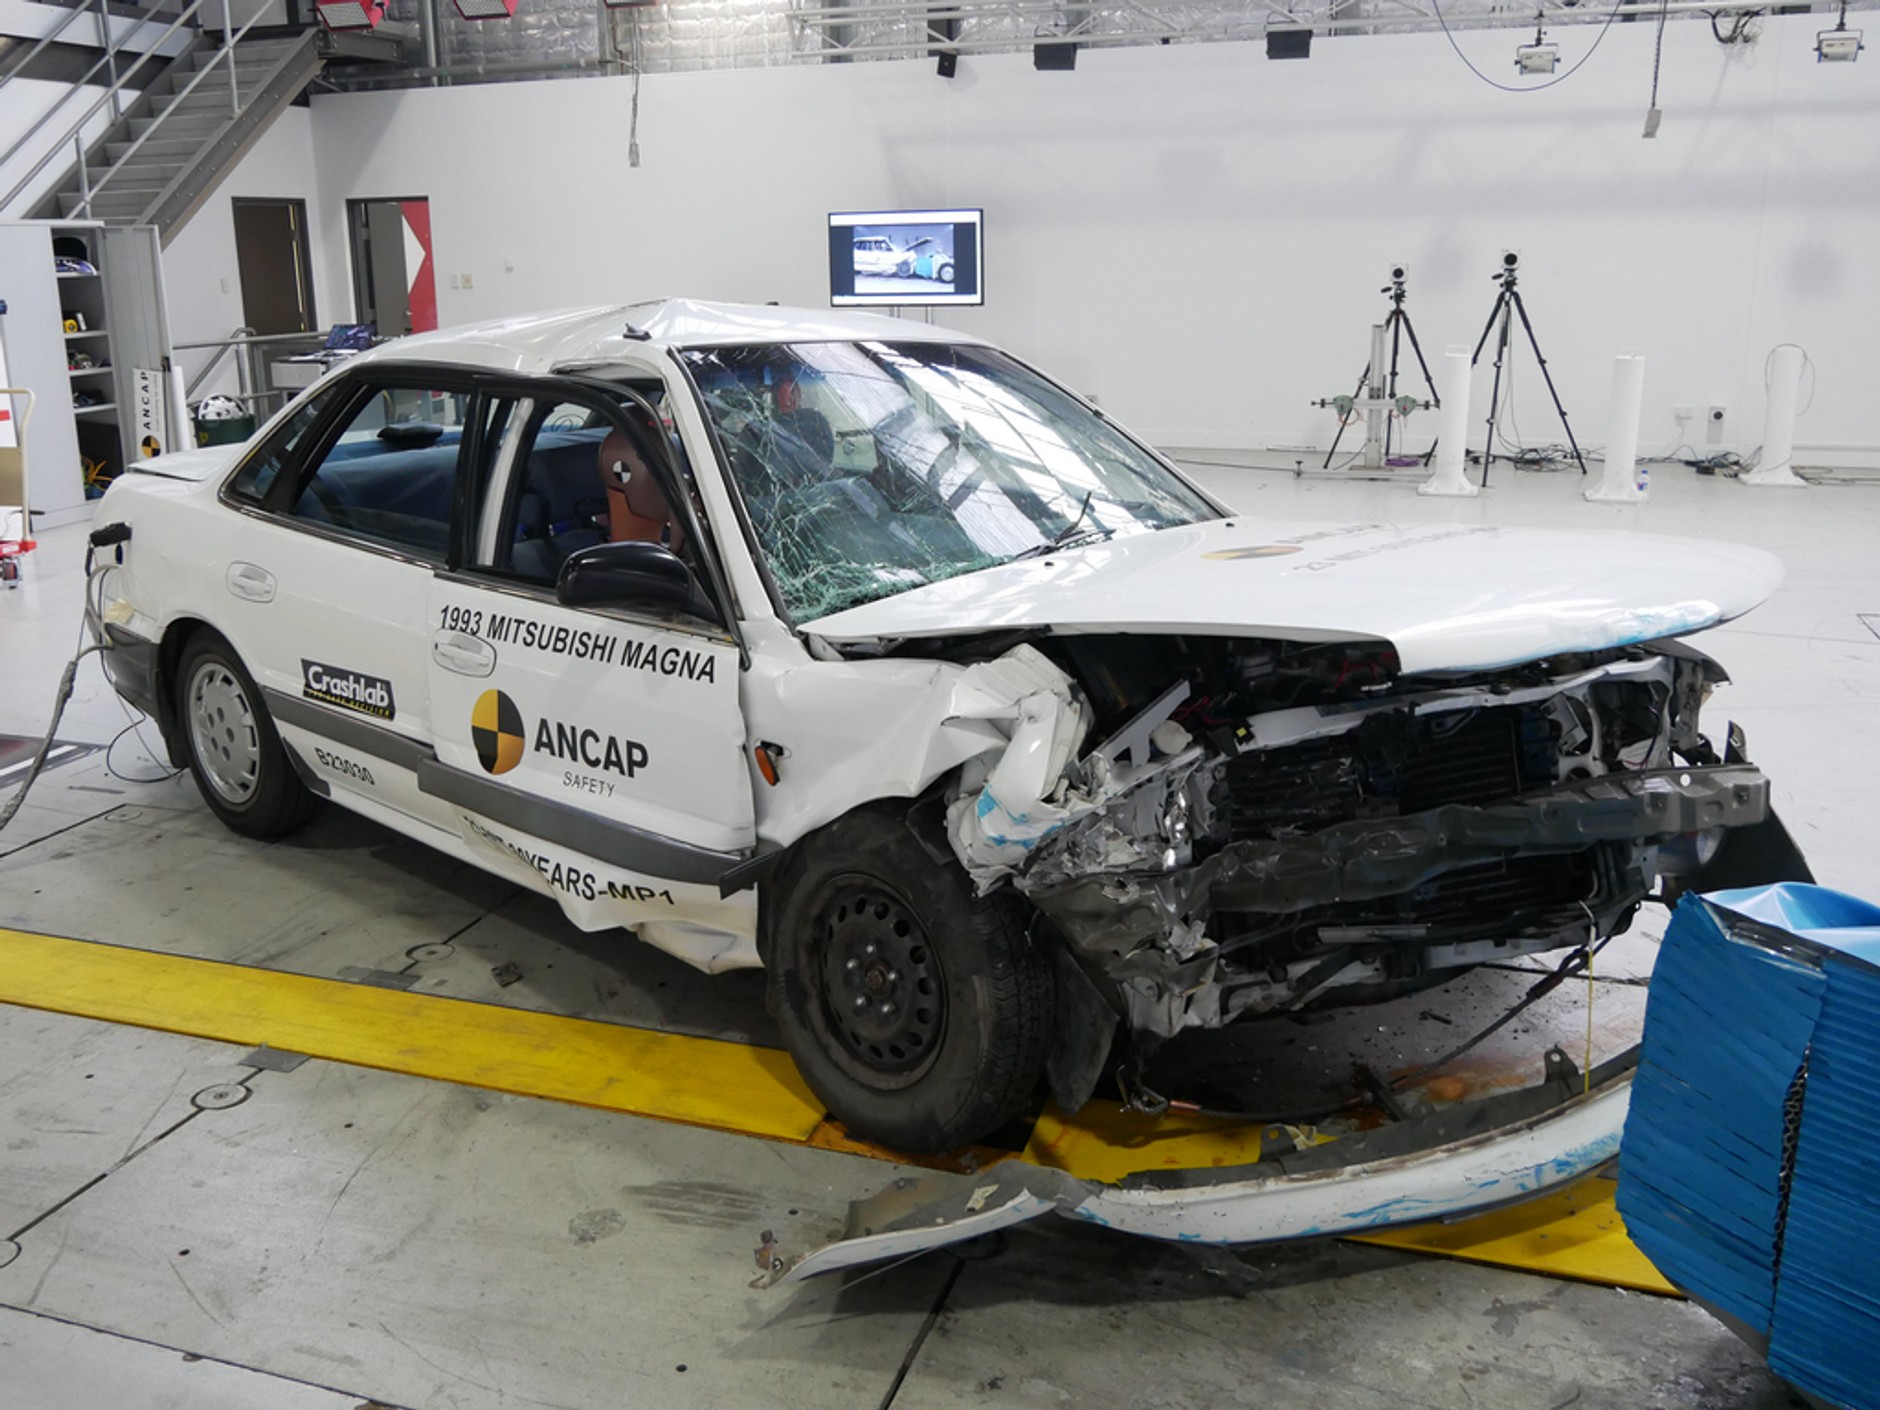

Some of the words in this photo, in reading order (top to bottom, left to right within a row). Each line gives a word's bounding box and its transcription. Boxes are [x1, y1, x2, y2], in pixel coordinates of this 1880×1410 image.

[140, 370, 152, 431] ANCAP
[439, 604, 482, 635] 1993
[486, 614, 616, 662] MITSUBISHI
[620, 640, 716, 684] MAGNA
[307, 664, 390, 708] Crashlab
[534, 718, 649, 779] ANCAP
[562, 771, 615, 797] SAFETY
